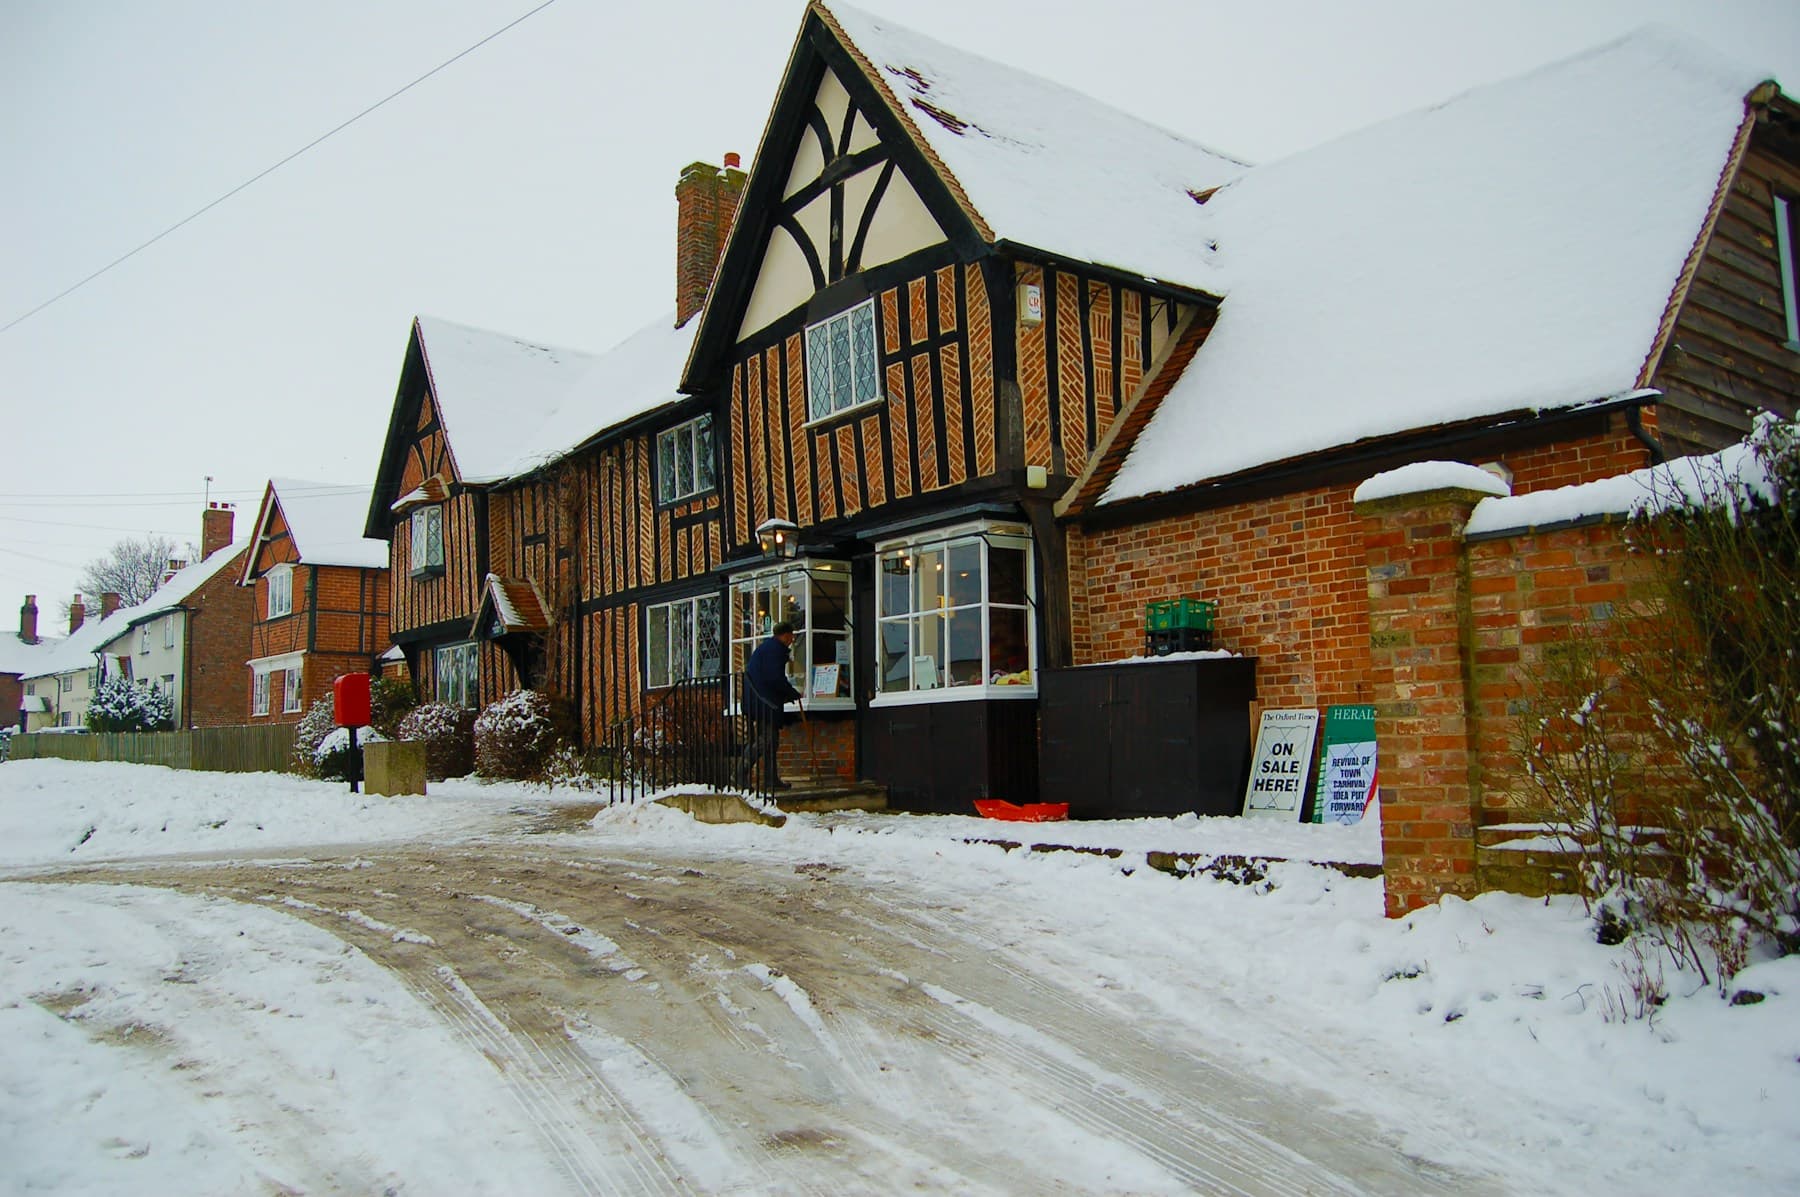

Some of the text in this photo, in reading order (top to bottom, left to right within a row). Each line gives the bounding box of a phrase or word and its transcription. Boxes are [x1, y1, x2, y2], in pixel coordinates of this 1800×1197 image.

[1276, 712, 1297, 721] Oxford
[1298, 712, 1316, 721] Times
[1333, 708, 1376, 720] HERAL
[1272, 743, 1294, 756] ON
[1332, 756, 1370, 767] REVIVAL OF
[1261, 760, 1300, 774] SALE
[1340, 768, 1361, 778] TOWN
[1254, 778, 1299, 792] HERE!
[1333, 779, 1366, 788] CARNIVAL
[1333, 791, 1365, 800] IDEA PUT
[1330, 802, 1365, 812] FORWARD
